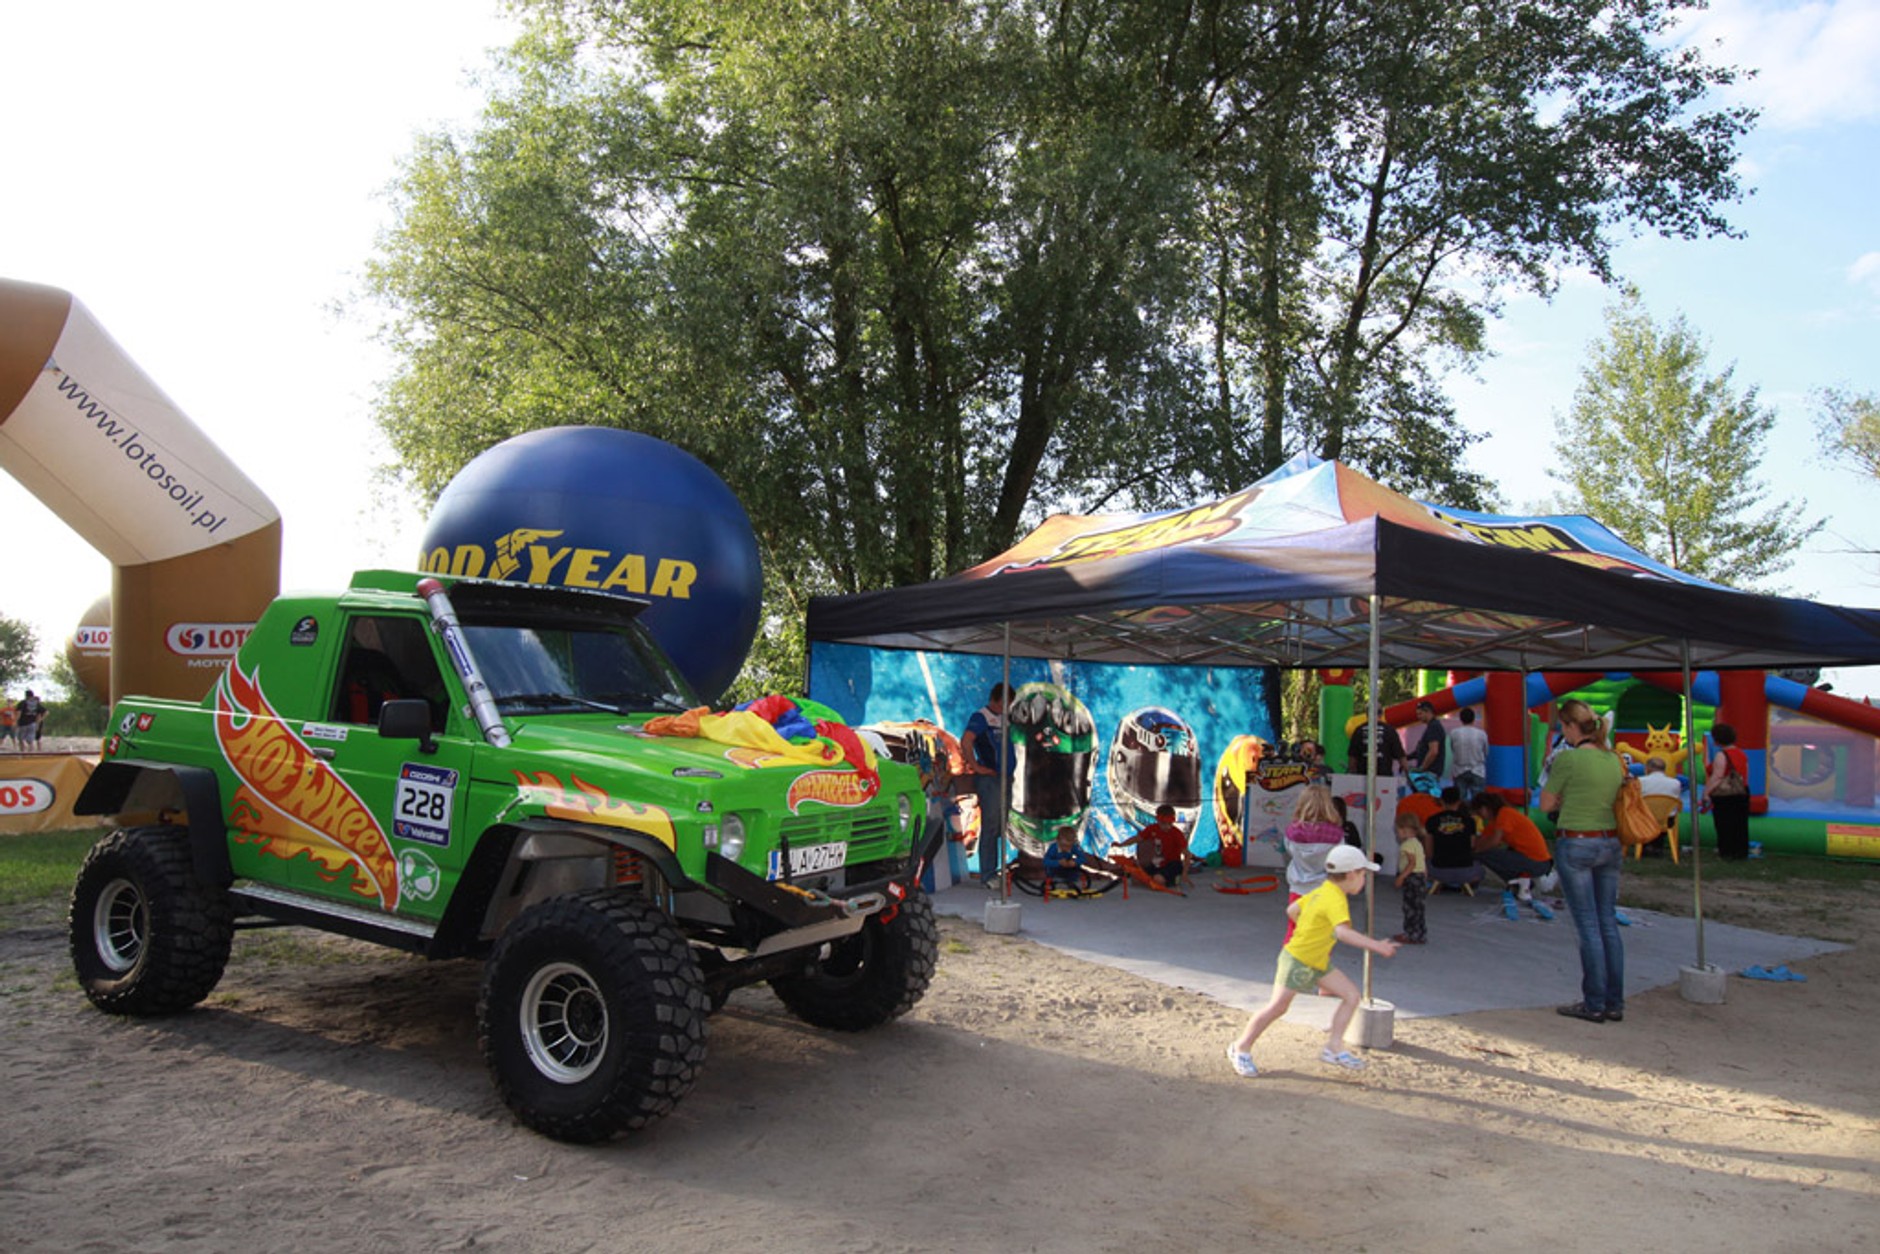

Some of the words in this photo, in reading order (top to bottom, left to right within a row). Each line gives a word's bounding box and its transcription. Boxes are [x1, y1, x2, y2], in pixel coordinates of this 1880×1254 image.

[58, 375, 228, 533] www.lotosoil.pl
[528, 544, 698, 600] YEAR
[208, 628, 252, 649] LOT
[401, 787, 446, 821] 228
